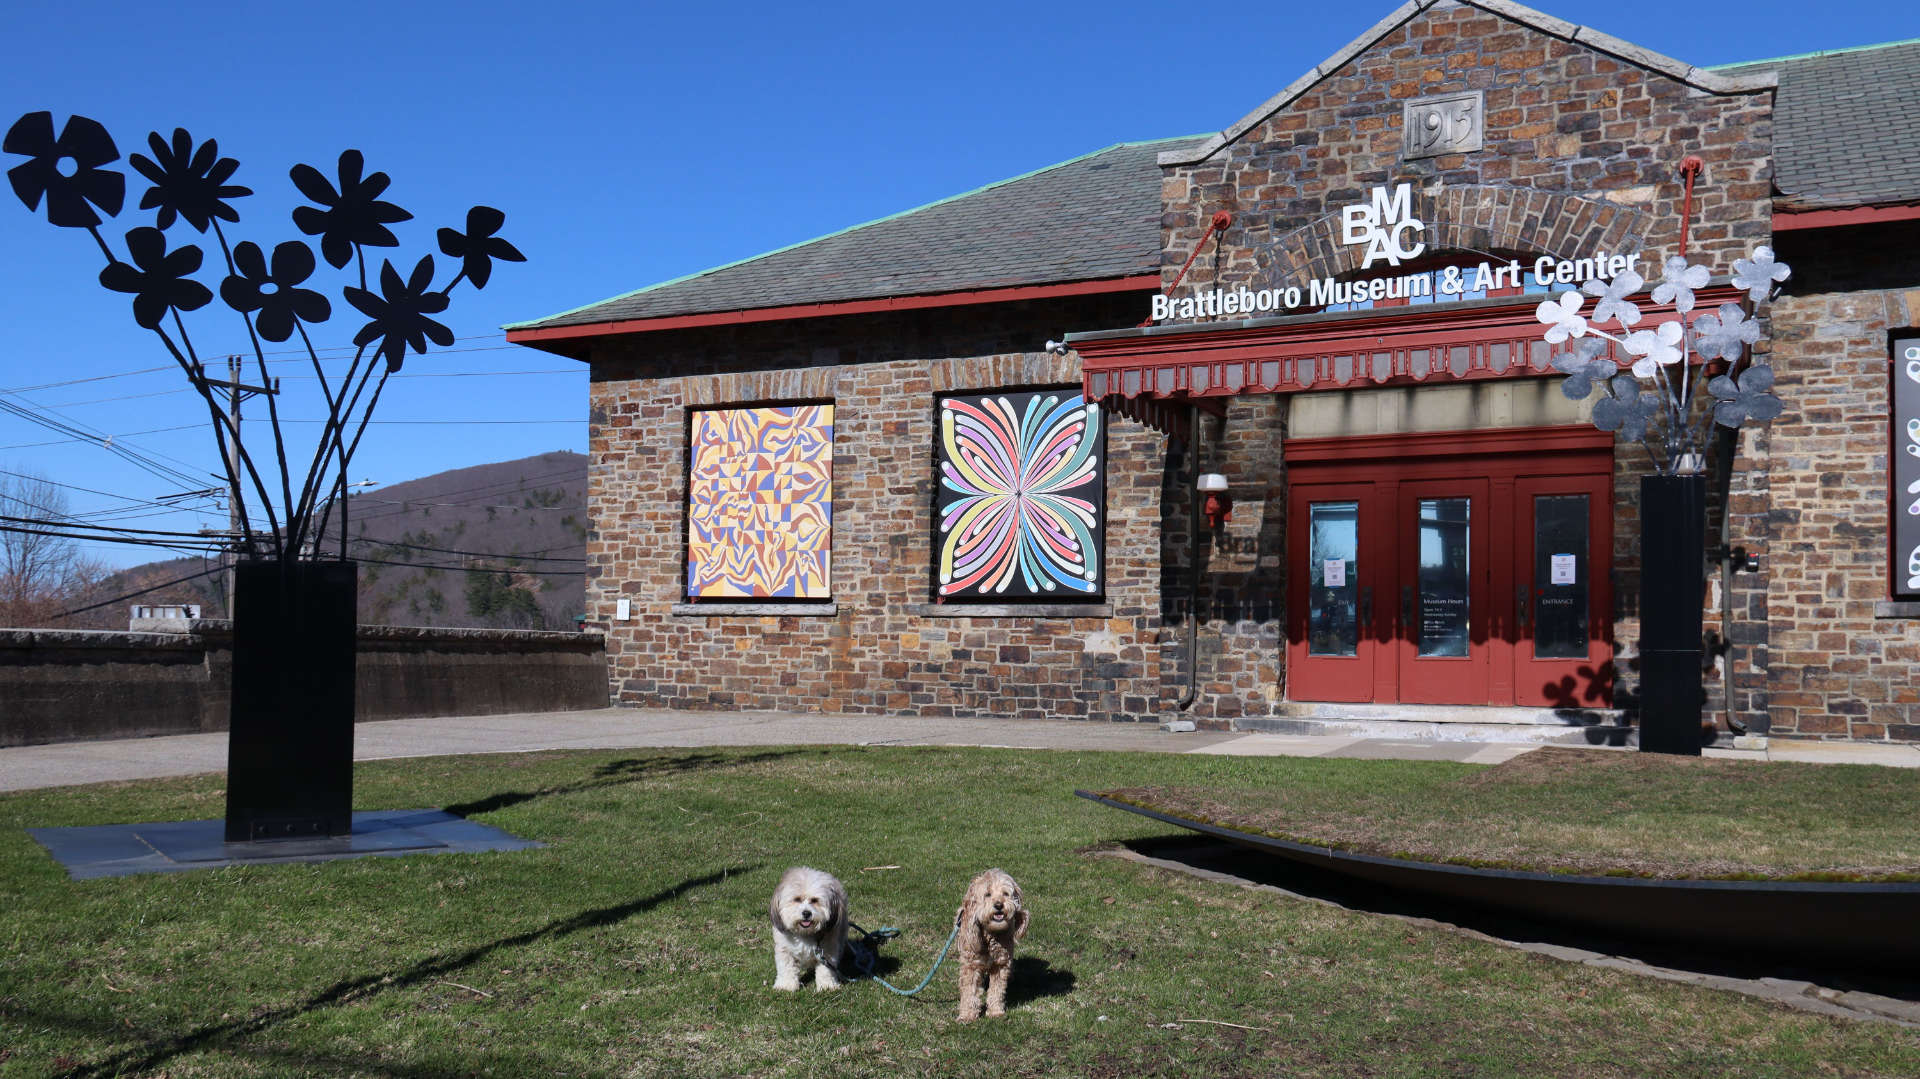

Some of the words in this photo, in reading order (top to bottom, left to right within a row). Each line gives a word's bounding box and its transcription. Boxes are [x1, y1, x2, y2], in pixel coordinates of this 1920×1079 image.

[1407, 103, 1473, 153] 1915
[1151, 285, 1301, 321] Brattleboro
[1309, 271, 1431, 307] Museum
[1441, 265, 1465, 295] &
[1473, 259, 1521, 292] Art
[1534, 250, 1640, 286] Center
